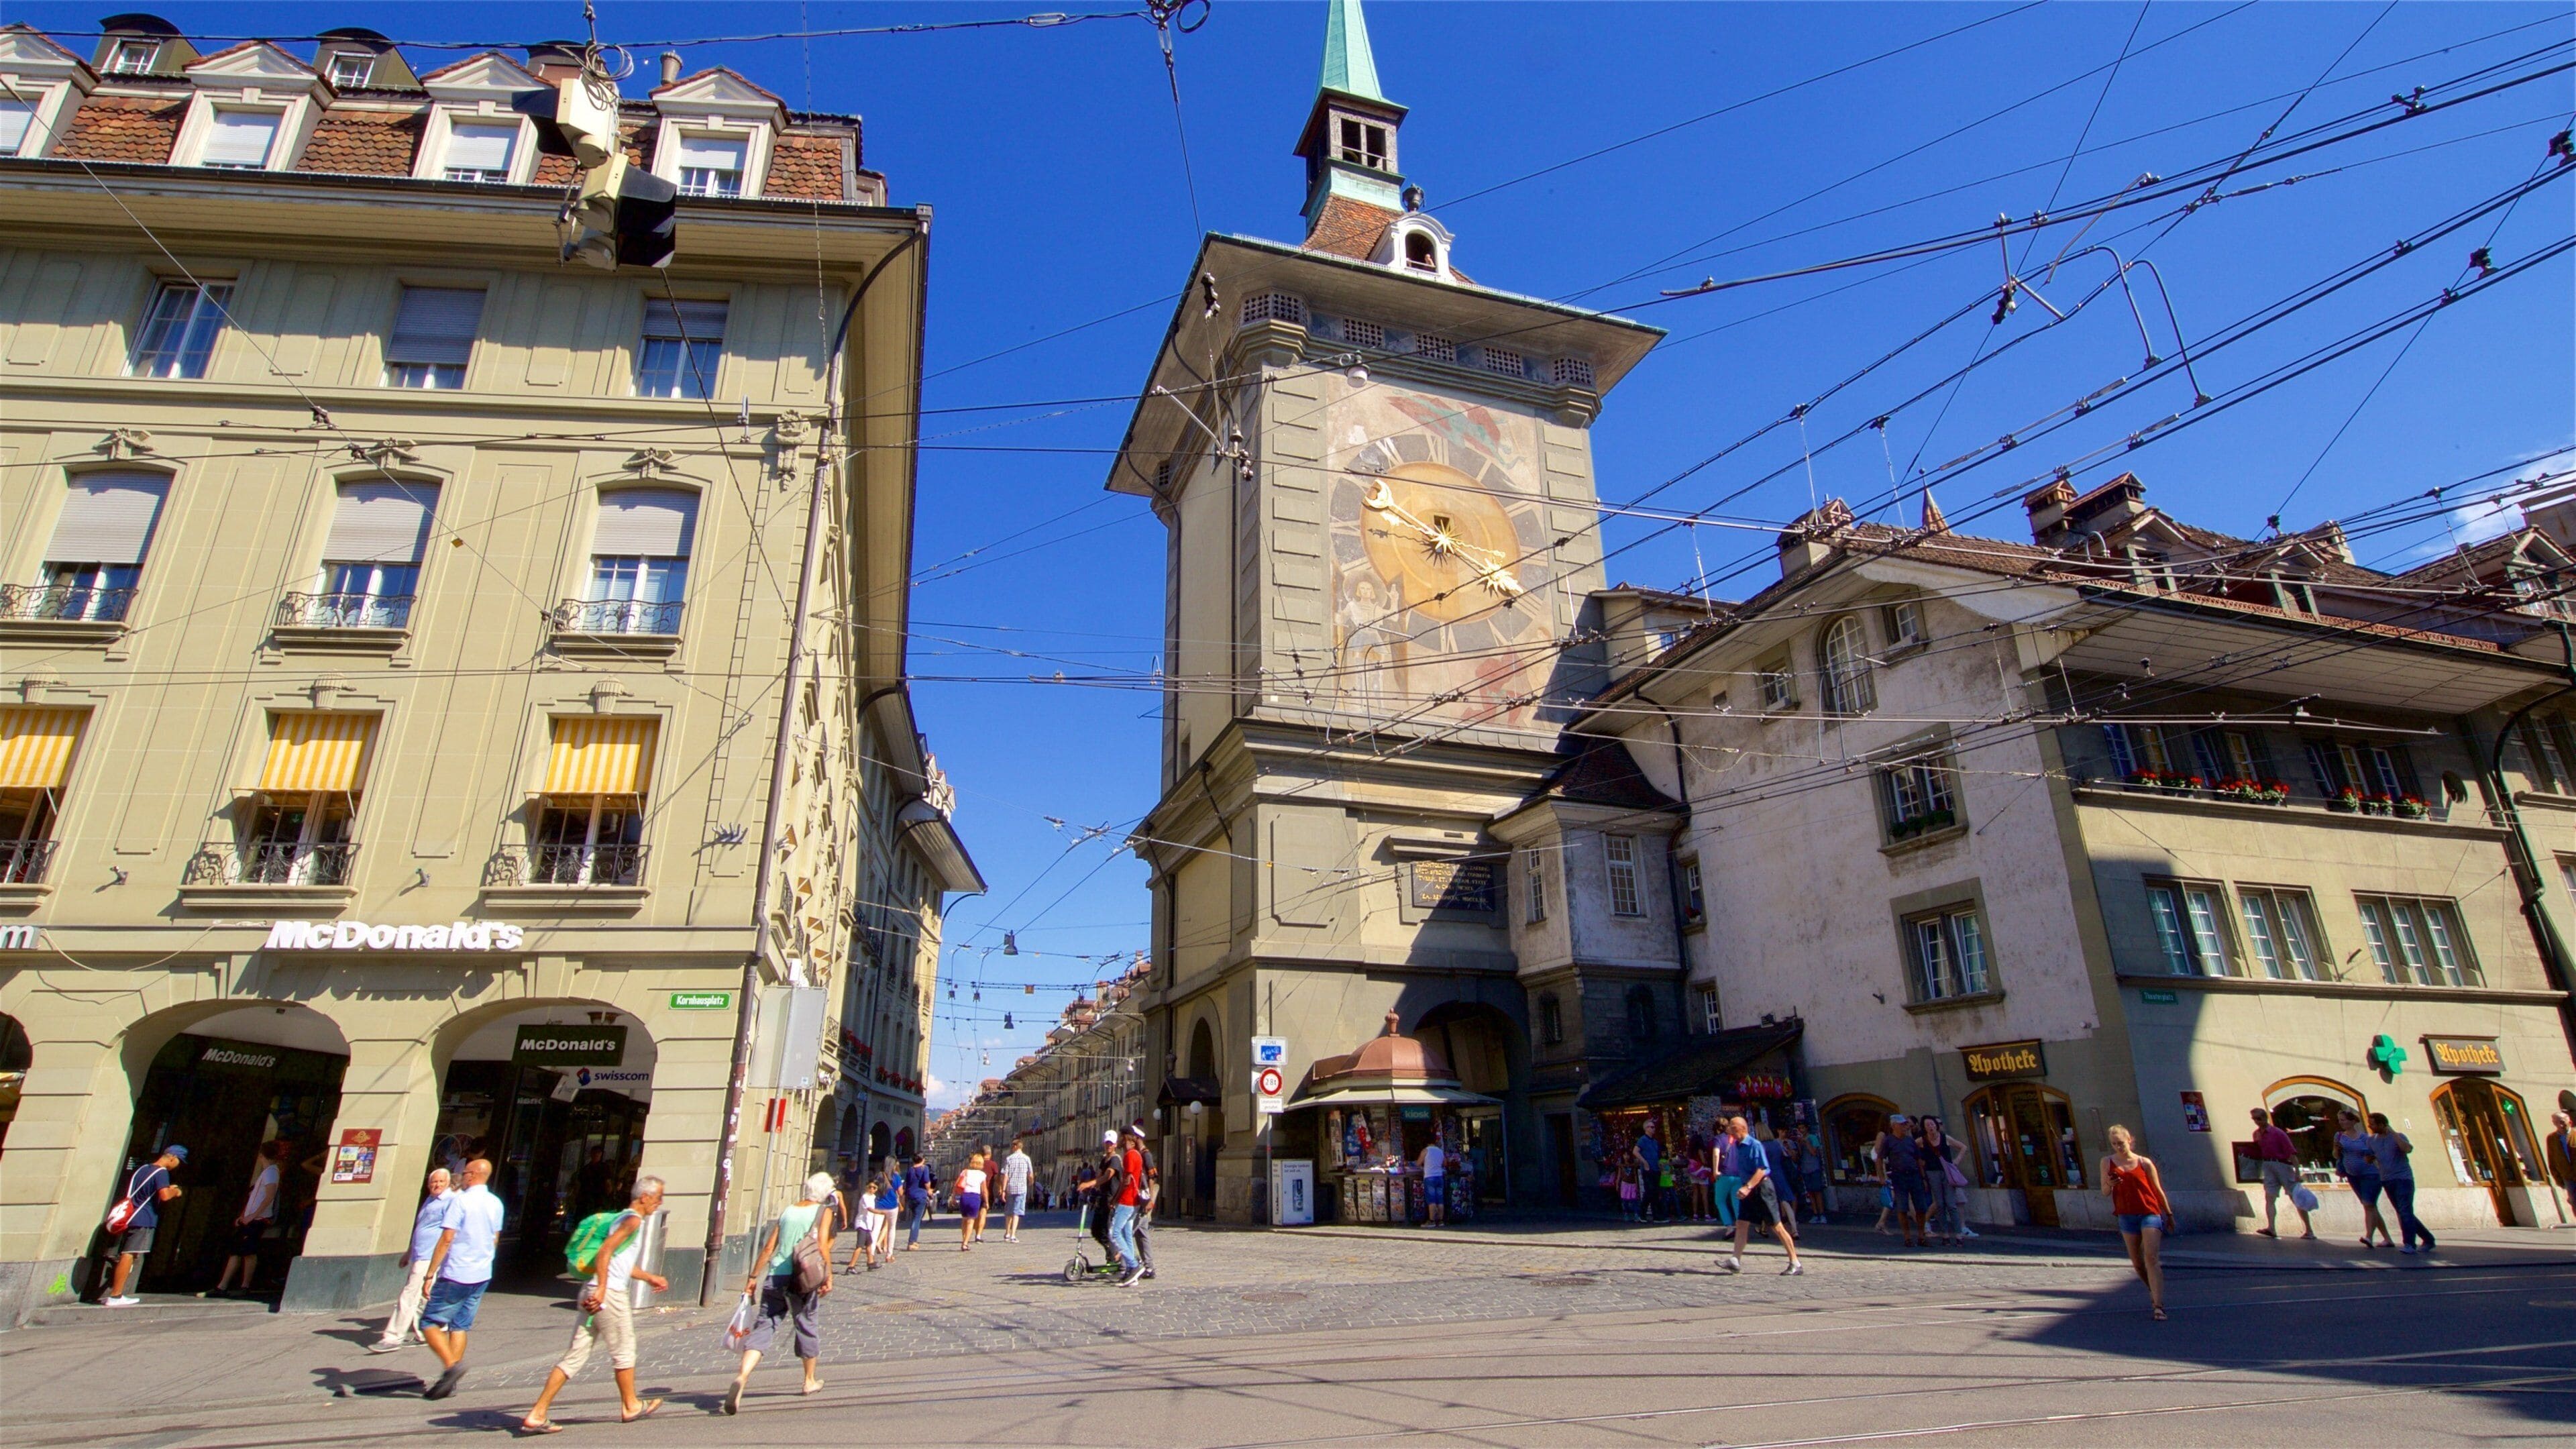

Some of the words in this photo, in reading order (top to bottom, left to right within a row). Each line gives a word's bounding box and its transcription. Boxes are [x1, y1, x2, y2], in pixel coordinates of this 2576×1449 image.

[265, 921, 524, 951] McDonald's
[676, 995, 724, 1007] Kornhausplatz
[520, 1039, 616, 1051] McDonald's
[201, 1048, 276, 1068] McDonald's
[1968, 1049, 2037, 1076] Apotheke
[2436, 1043, 2499, 1067] Apotheke
[594, 1071, 649, 1081] swisscom
[1405, 1110, 1429, 1118] kiosk
